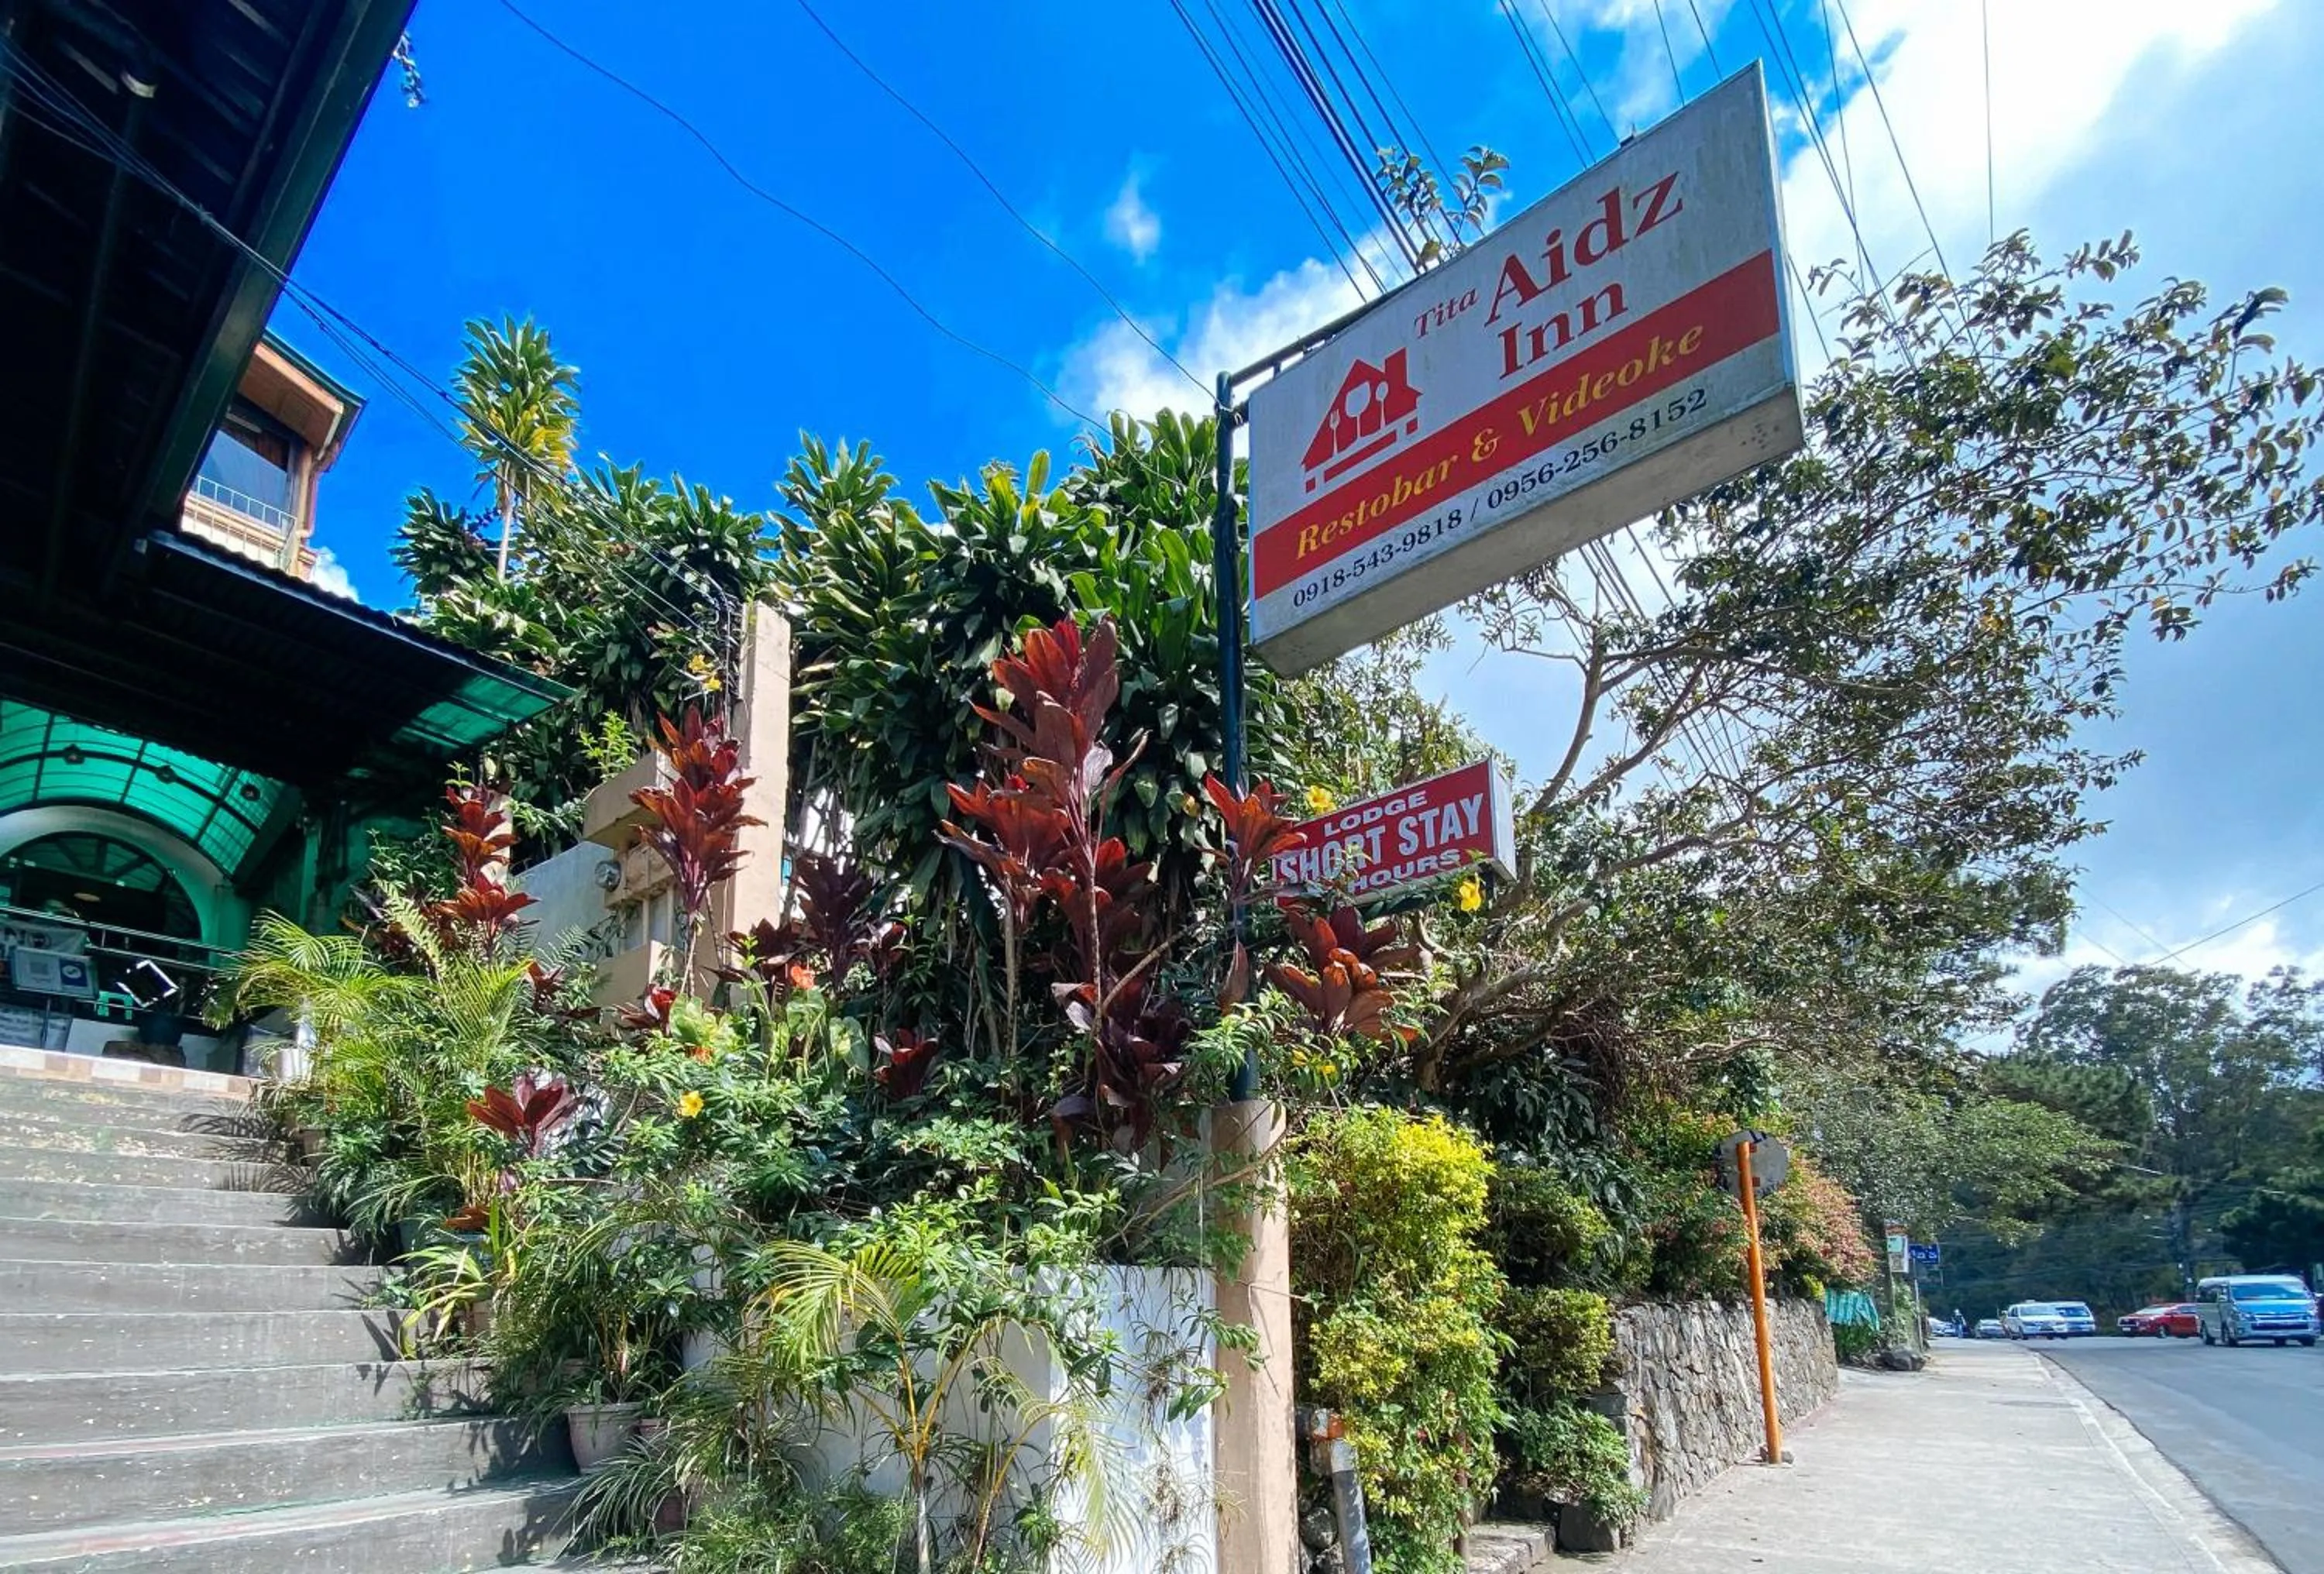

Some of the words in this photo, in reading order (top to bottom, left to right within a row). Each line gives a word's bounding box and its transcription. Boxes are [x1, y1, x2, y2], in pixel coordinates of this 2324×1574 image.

[1414, 287, 1479, 339] Tita
[1483, 170, 1683, 327] Aidz
[1498, 282, 1628, 380] Inn
[1296, 455, 1458, 560] Restobar
[1471, 428, 1501, 462] &
[1518, 325, 1703, 435] Videoke
[1293, 508, 1463, 608] 0918-543-9818
[1487, 388, 1707, 509] 0956-256-8152
[1280, 824, 1386, 885] SHORT
[1398, 792, 1483, 856] STAY
[1324, 789, 1428, 837] LODGE
[1347, 848, 1460, 893] HOURS
